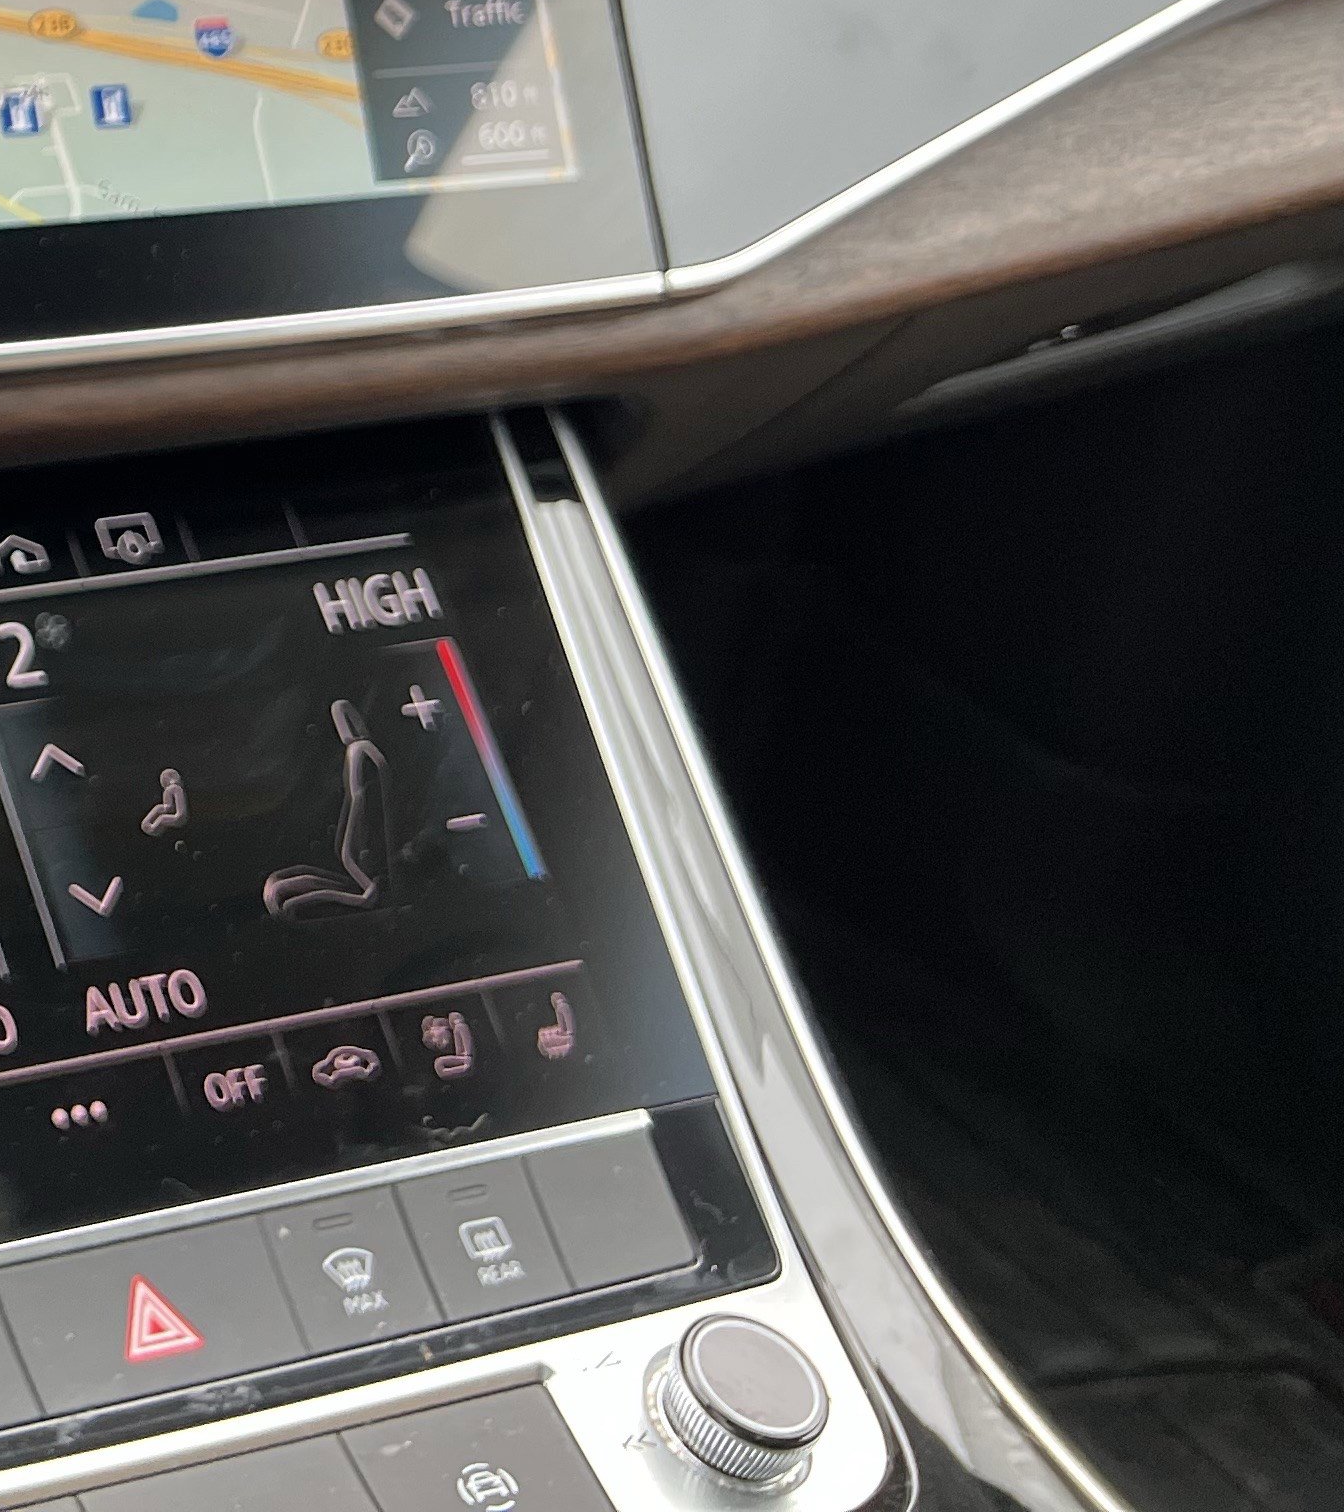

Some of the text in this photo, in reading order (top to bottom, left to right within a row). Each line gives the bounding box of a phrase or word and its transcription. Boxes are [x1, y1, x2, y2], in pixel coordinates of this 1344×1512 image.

[478, 120, 528, 152] 600
[312, 567, 444, 635] HIGH
[84, 967, 209, 1035] AUTO
[203, 1062, 268, 1114] OFF
[476, 1258, 529, 1288] REAR
[342, 1288, 390, 1319] MAX
